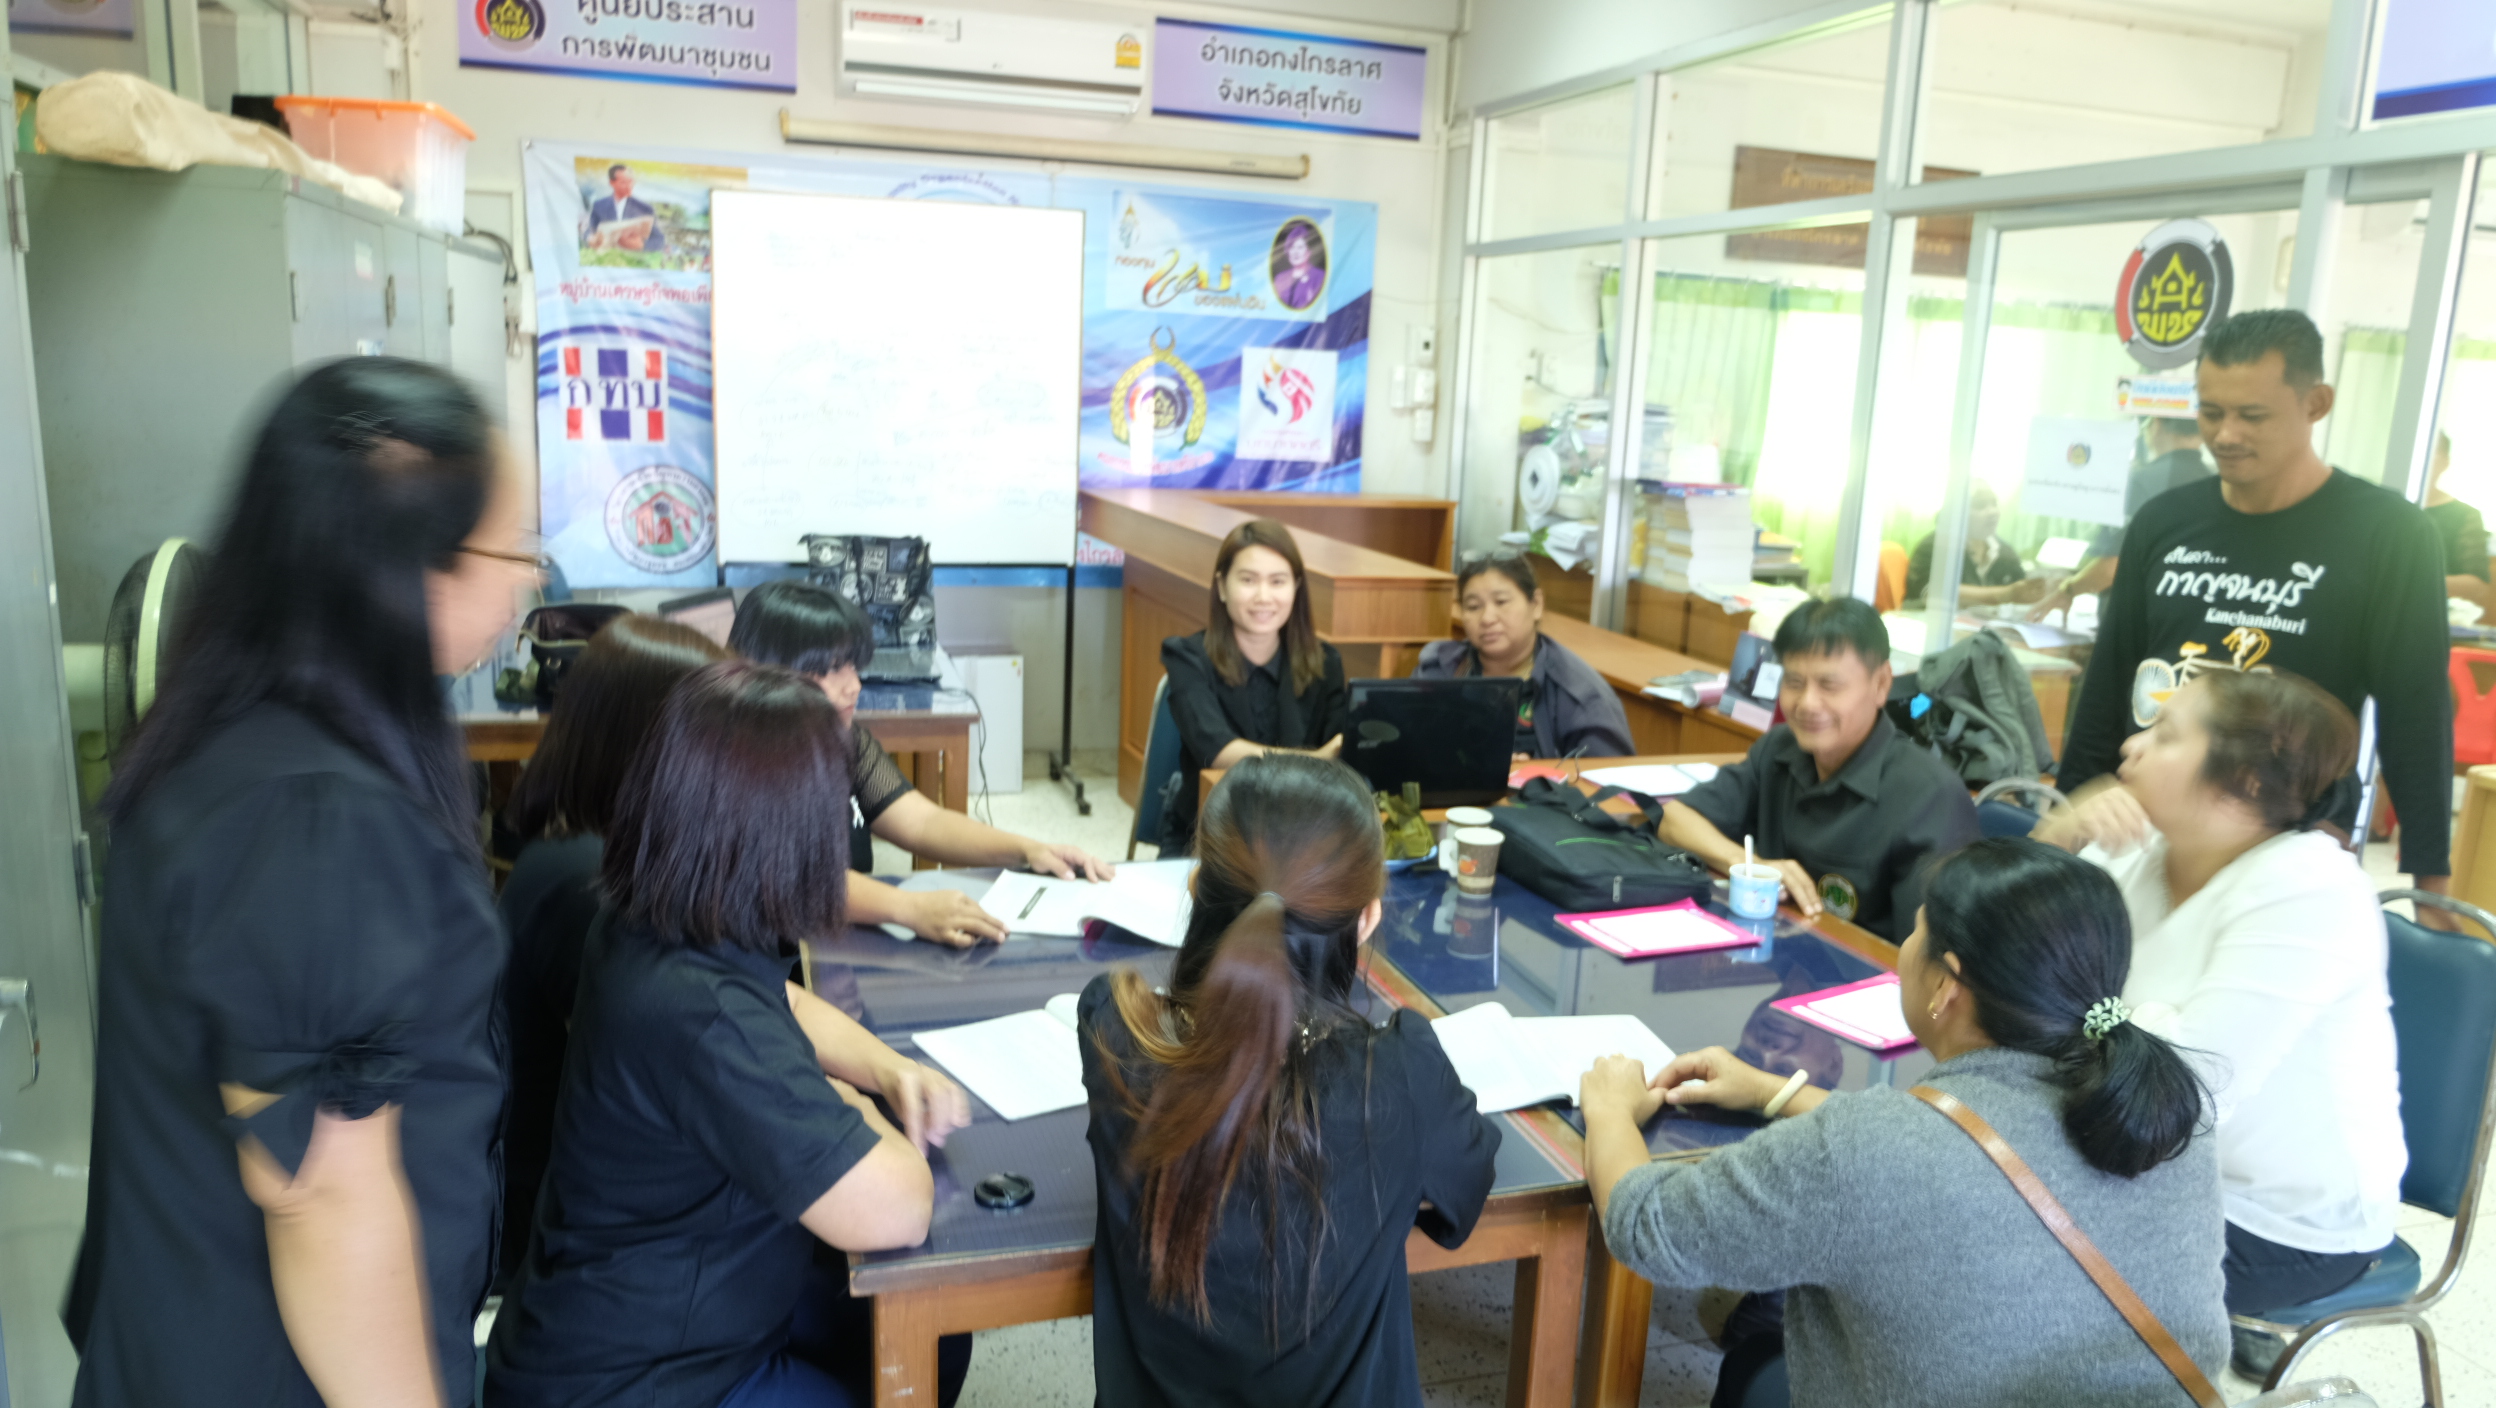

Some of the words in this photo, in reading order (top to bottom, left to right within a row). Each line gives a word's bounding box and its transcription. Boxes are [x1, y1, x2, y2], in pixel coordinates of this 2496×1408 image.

[577, 0, 755, 29] ศูนยประสาน
[561, 32, 771, 77] การพัฒนาชุมชน
[1200, 36, 1382, 81] อำเภอกงไกรลาศ
[1218, 77, 1362, 119] จังหวัดสุโขทัย
[2155, 561, 2325, 615] กาญจนบุรี
[2204, 606, 2308, 636] Kanchanaburi
